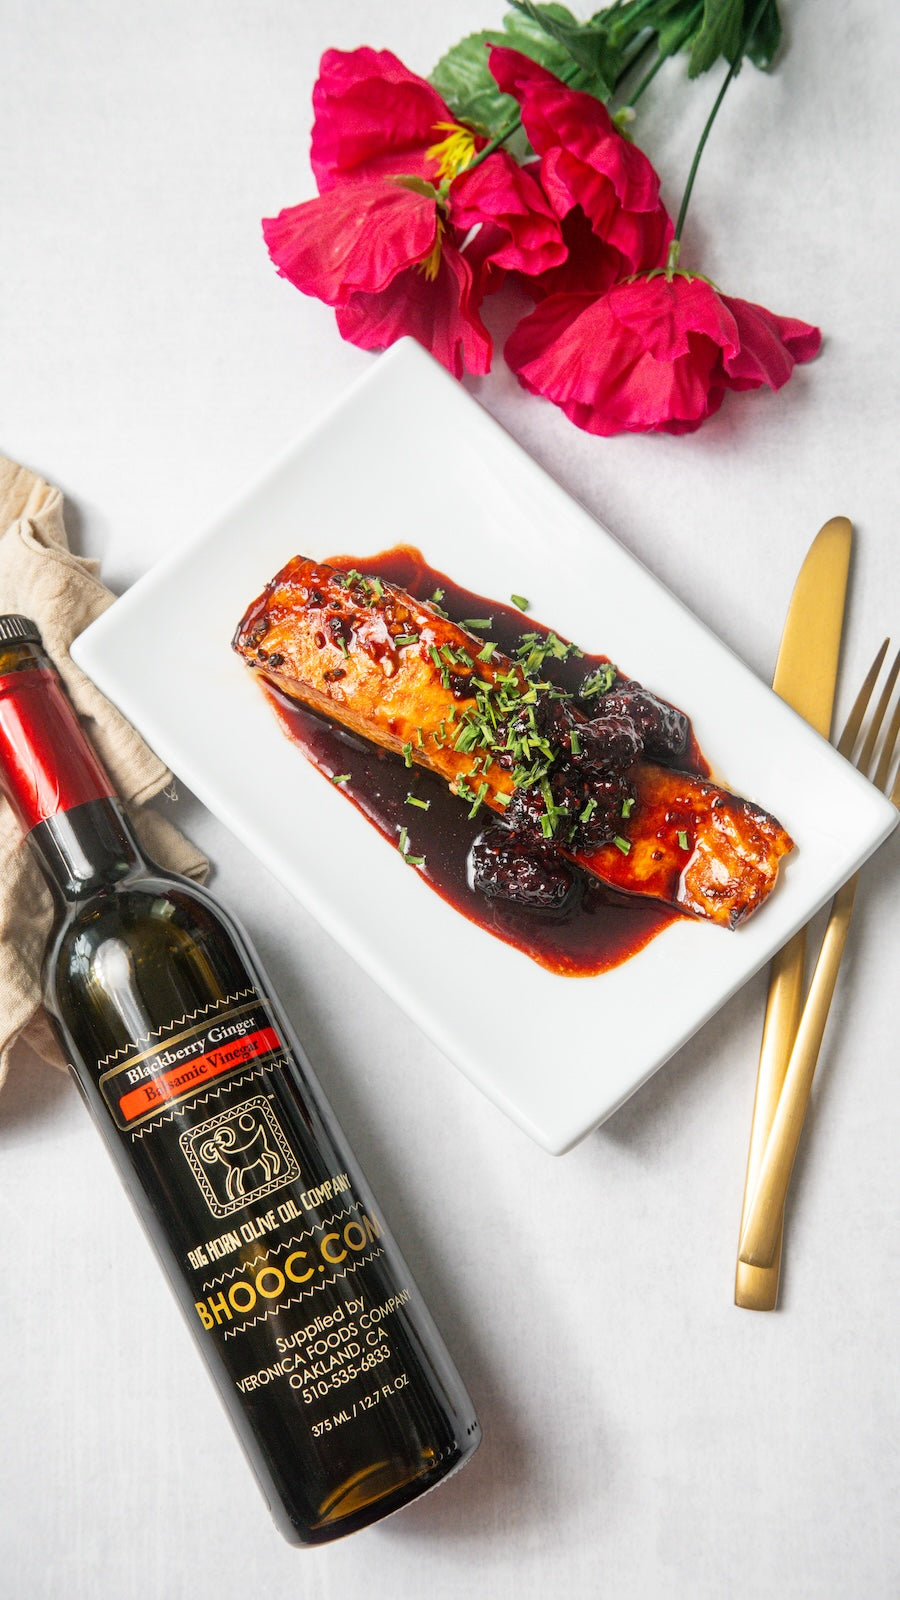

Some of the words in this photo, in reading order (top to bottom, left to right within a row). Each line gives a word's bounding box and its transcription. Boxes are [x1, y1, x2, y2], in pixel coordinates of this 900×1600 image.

[126, 1038, 205, 1084] Blackberry
[208, 1017, 256, 1043] Ginger
[143, 1064, 208, 1102] Balsamic
[207, 1039, 259, 1068] Vinegar
[187, 1247, 209, 1270] BIG
[204, 1230, 242, 1262] HORN
[240, 1210, 279, 1243] OLIVE
[277, 1200, 302, 1222] OIL
[300, 1173, 351, 1211] COMPANY
[195, 1209, 385, 1330] BHOOC.COM
[236, 1353, 306, 1393] VERONICA
[306, 1322, 358, 1360] FOODS
[359, 1288, 411, 1329] COMPANY
[276, 1306, 345, 1353] Supplied
[345, 1296, 364, 1314] by
[289, 1342, 365, 1389] OAKLAND,
[366, 1327, 388, 1346] CA
[302, 1345, 391, 1404] 510-535-6833
[311, 1420, 332, 1437] 375
[333, 1410, 351, 1427] ML
[359, 1390, 380, 1411] 12.7
[382, 1385, 395, 1398] FL
[394, 1373, 410, 1389] OZ
